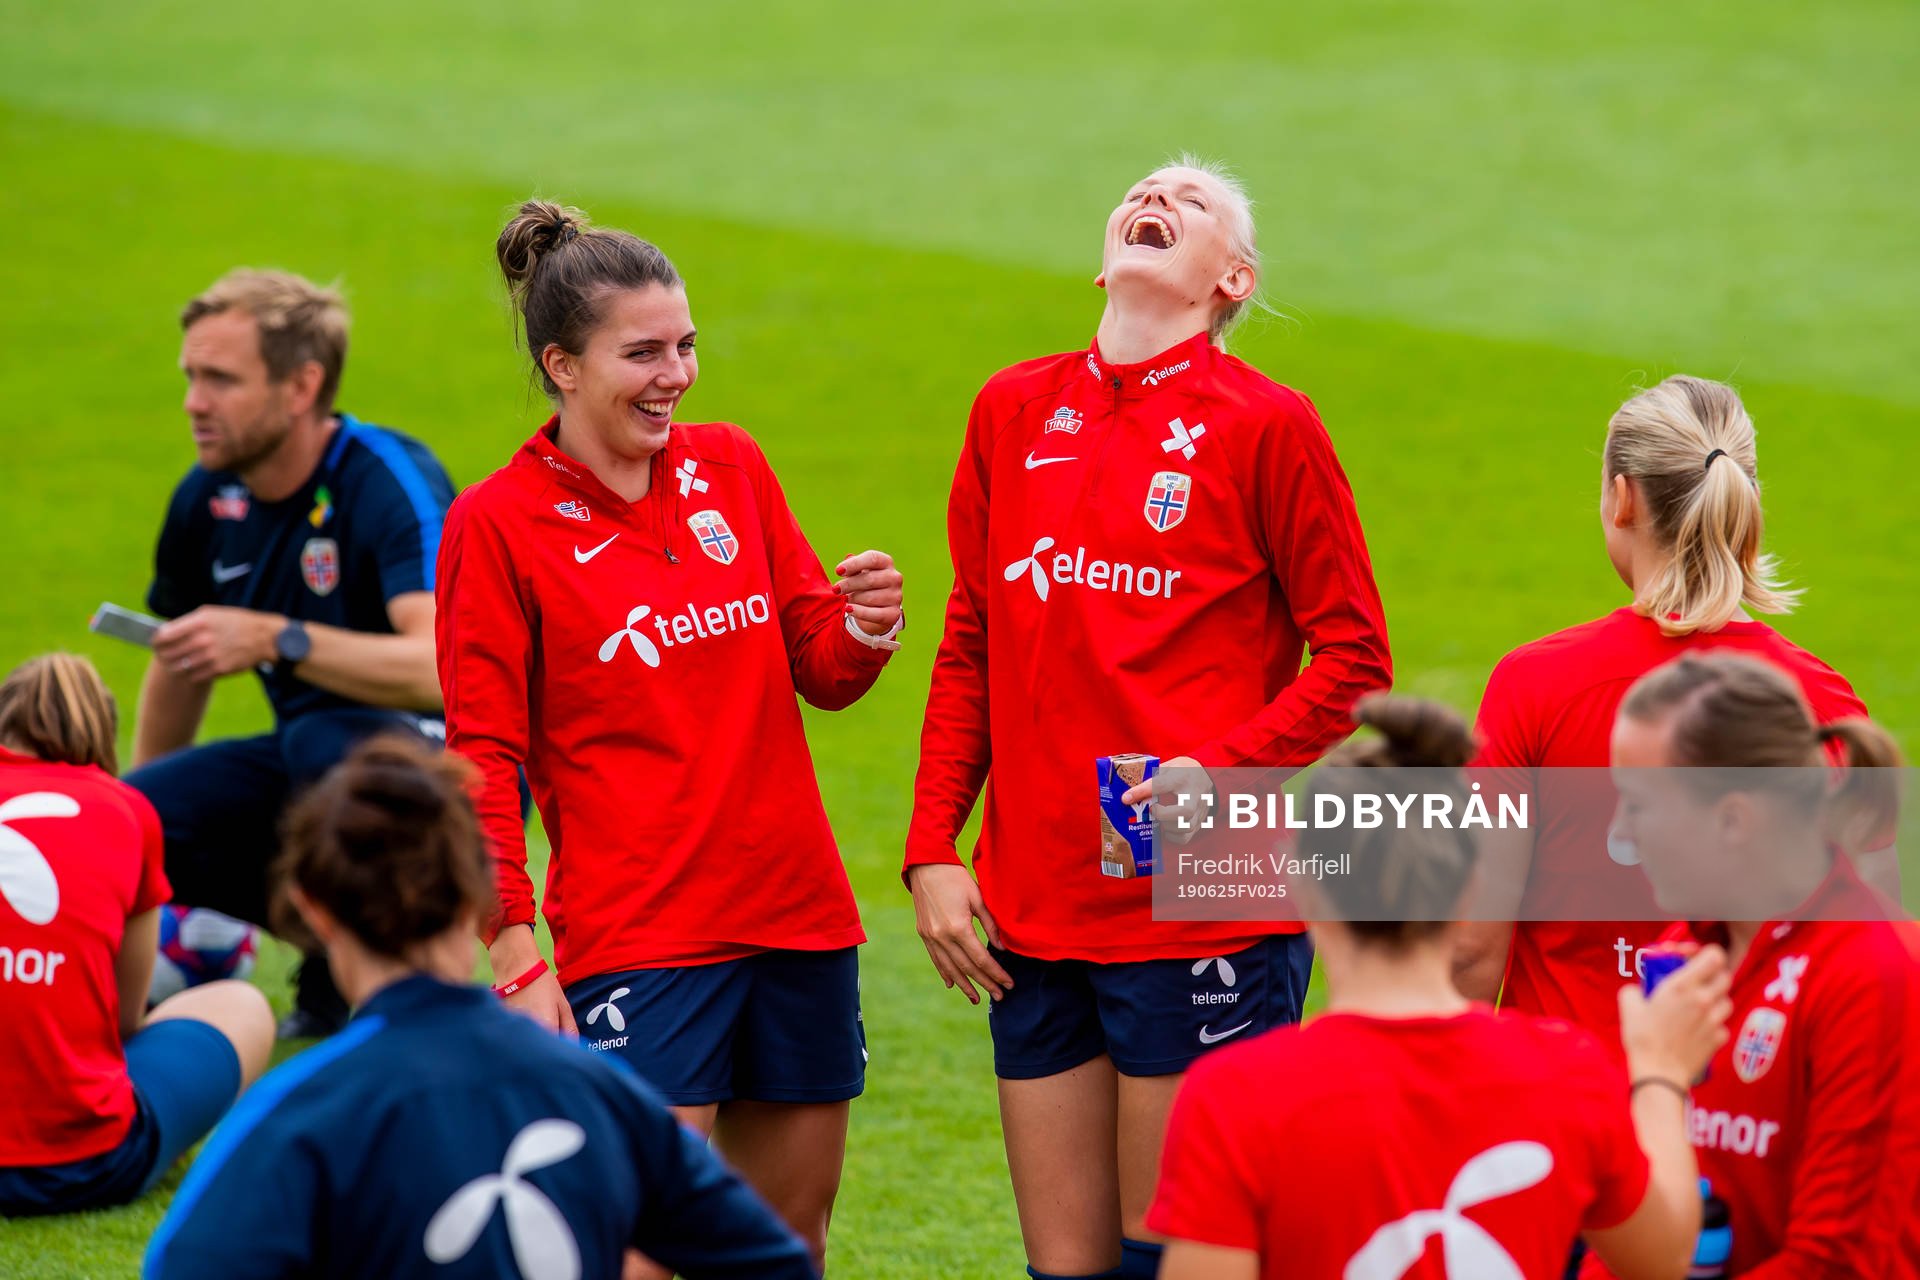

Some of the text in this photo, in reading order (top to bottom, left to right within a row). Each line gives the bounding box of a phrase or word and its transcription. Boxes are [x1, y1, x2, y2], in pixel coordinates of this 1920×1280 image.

[1155, 360, 1191, 381] telenor
[1049, 419, 1076, 431] TINE
[1052, 546, 1182, 599] elenor
[653, 592, 770, 648] teleno
[1191, 991, 1240, 1005] telenor
